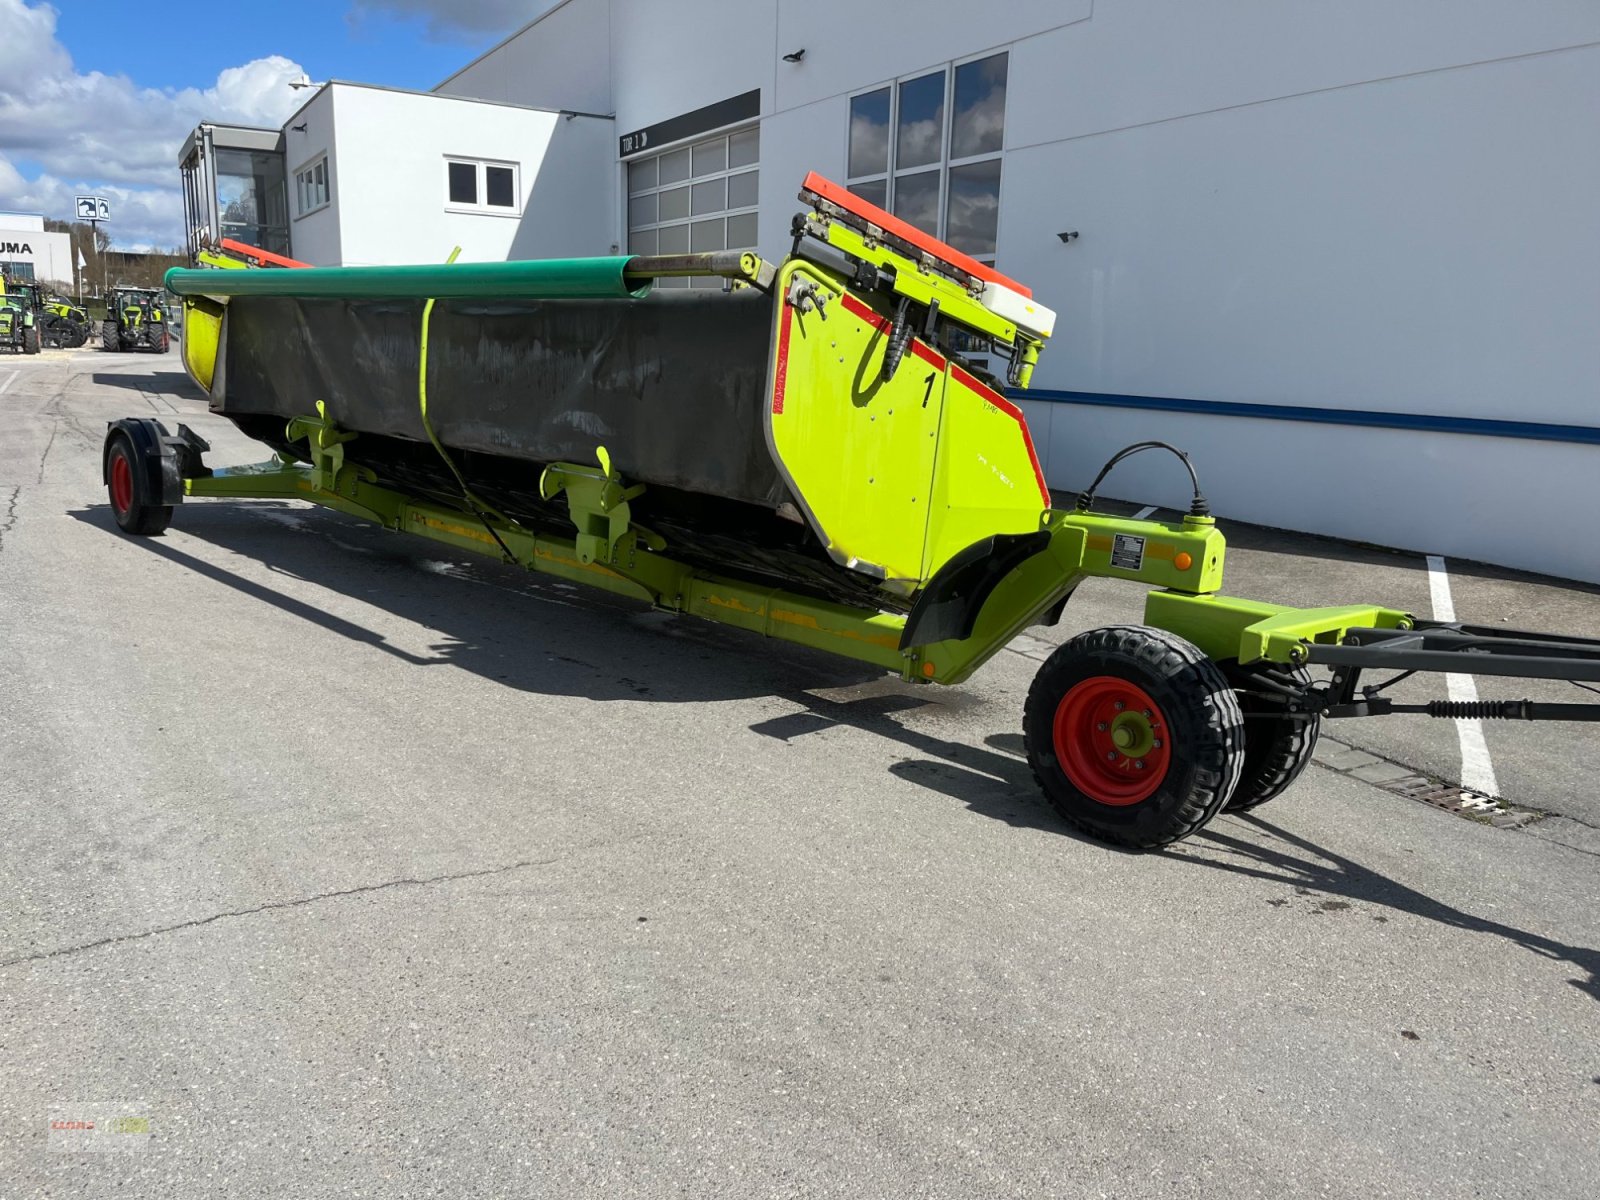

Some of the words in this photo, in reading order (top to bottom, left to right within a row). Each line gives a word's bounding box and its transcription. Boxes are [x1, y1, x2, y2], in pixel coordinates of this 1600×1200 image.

[622, 136, 633, 153] TOR
[634, 134, 639, 149] 1
[922, 371, 936, 409] 1
